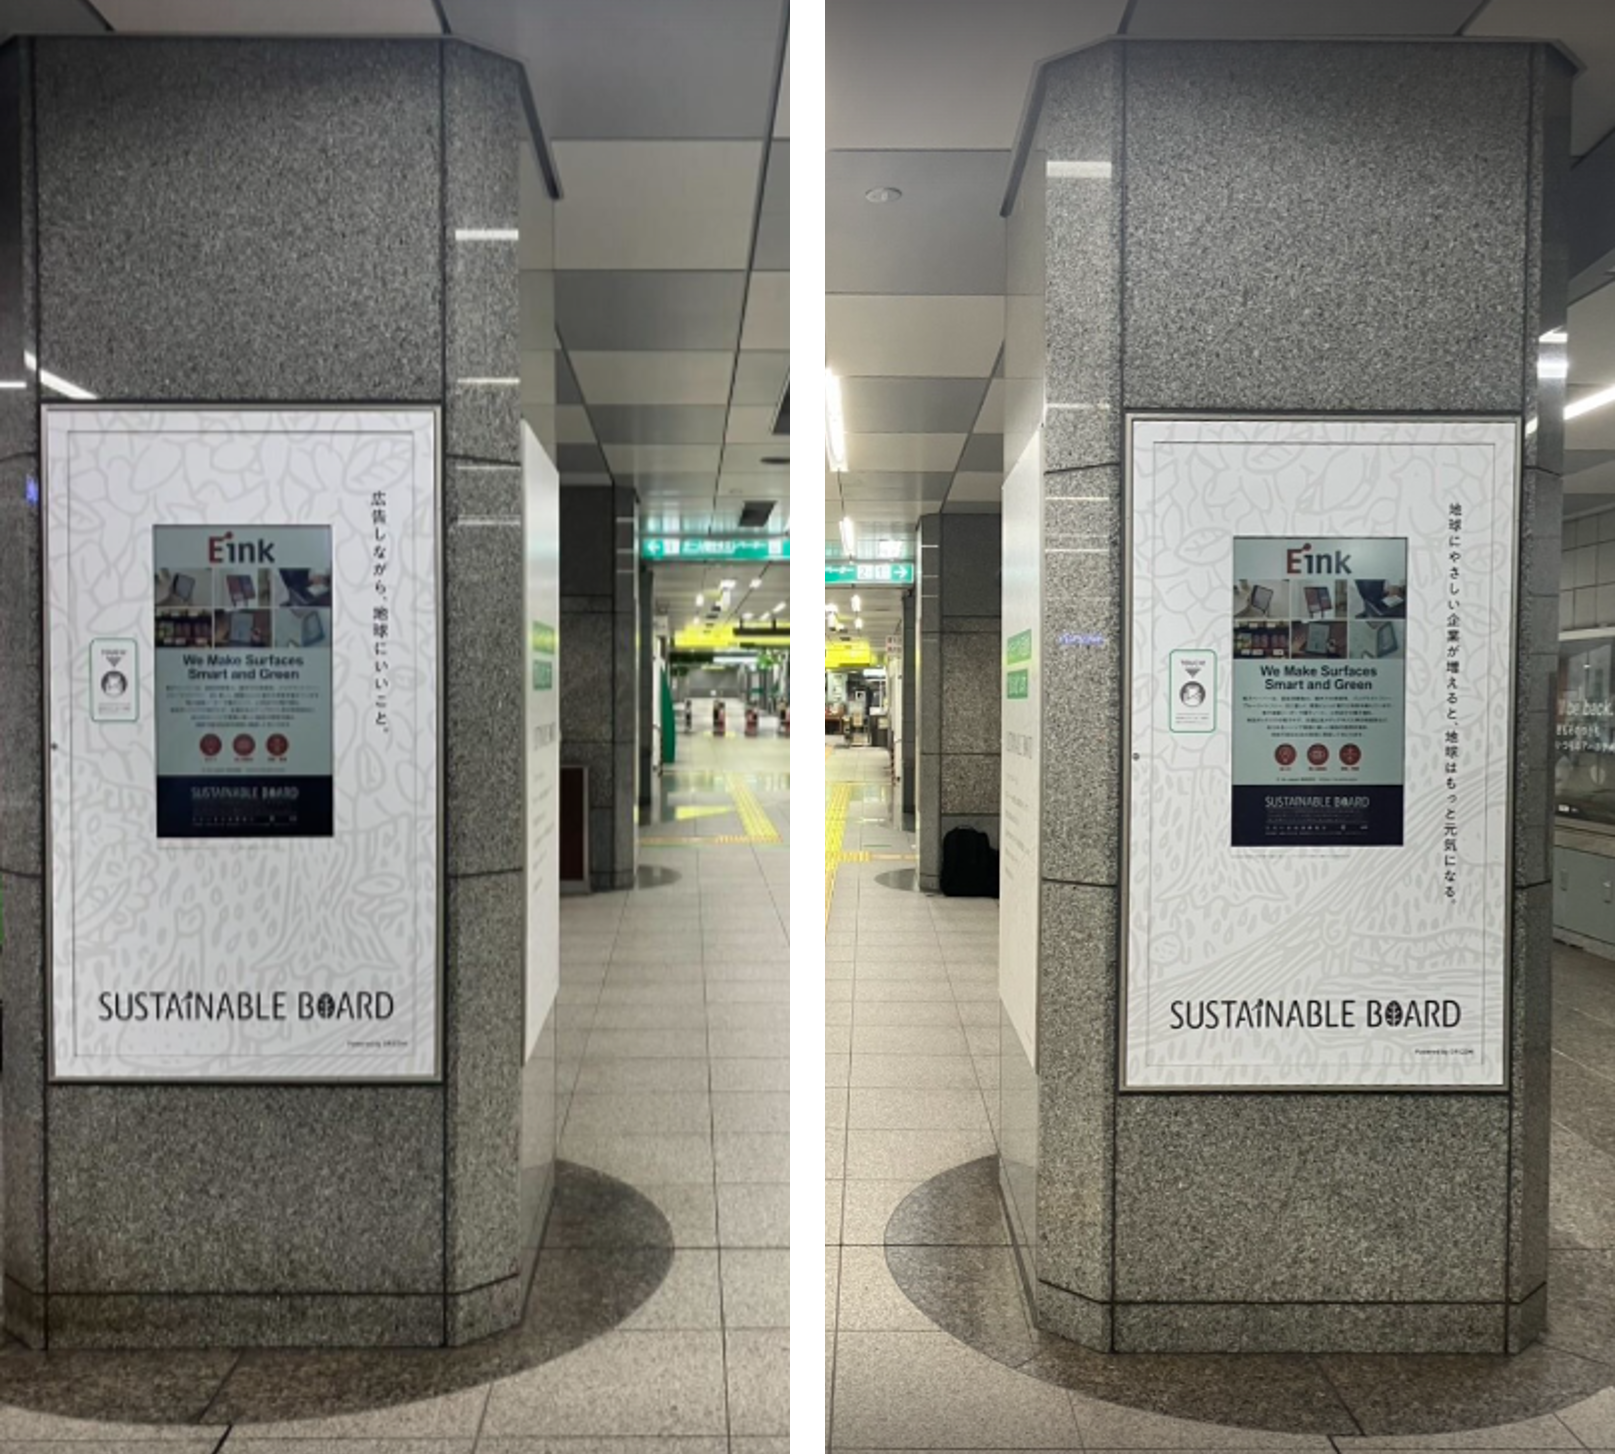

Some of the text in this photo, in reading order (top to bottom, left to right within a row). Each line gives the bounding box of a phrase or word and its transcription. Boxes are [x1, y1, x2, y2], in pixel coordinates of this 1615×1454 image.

[183, 654, 304, 666] We Make Surfaces
[188, 668, 300, 680] Smart and Green
[1260, 665, 1377, 677] We Make Surfaces
[1265, 678, 1373, 690] Smart and Green
[298, 991, 395, 1020] BOARD
[1367, 1000, 1462, 1028] BOARD
